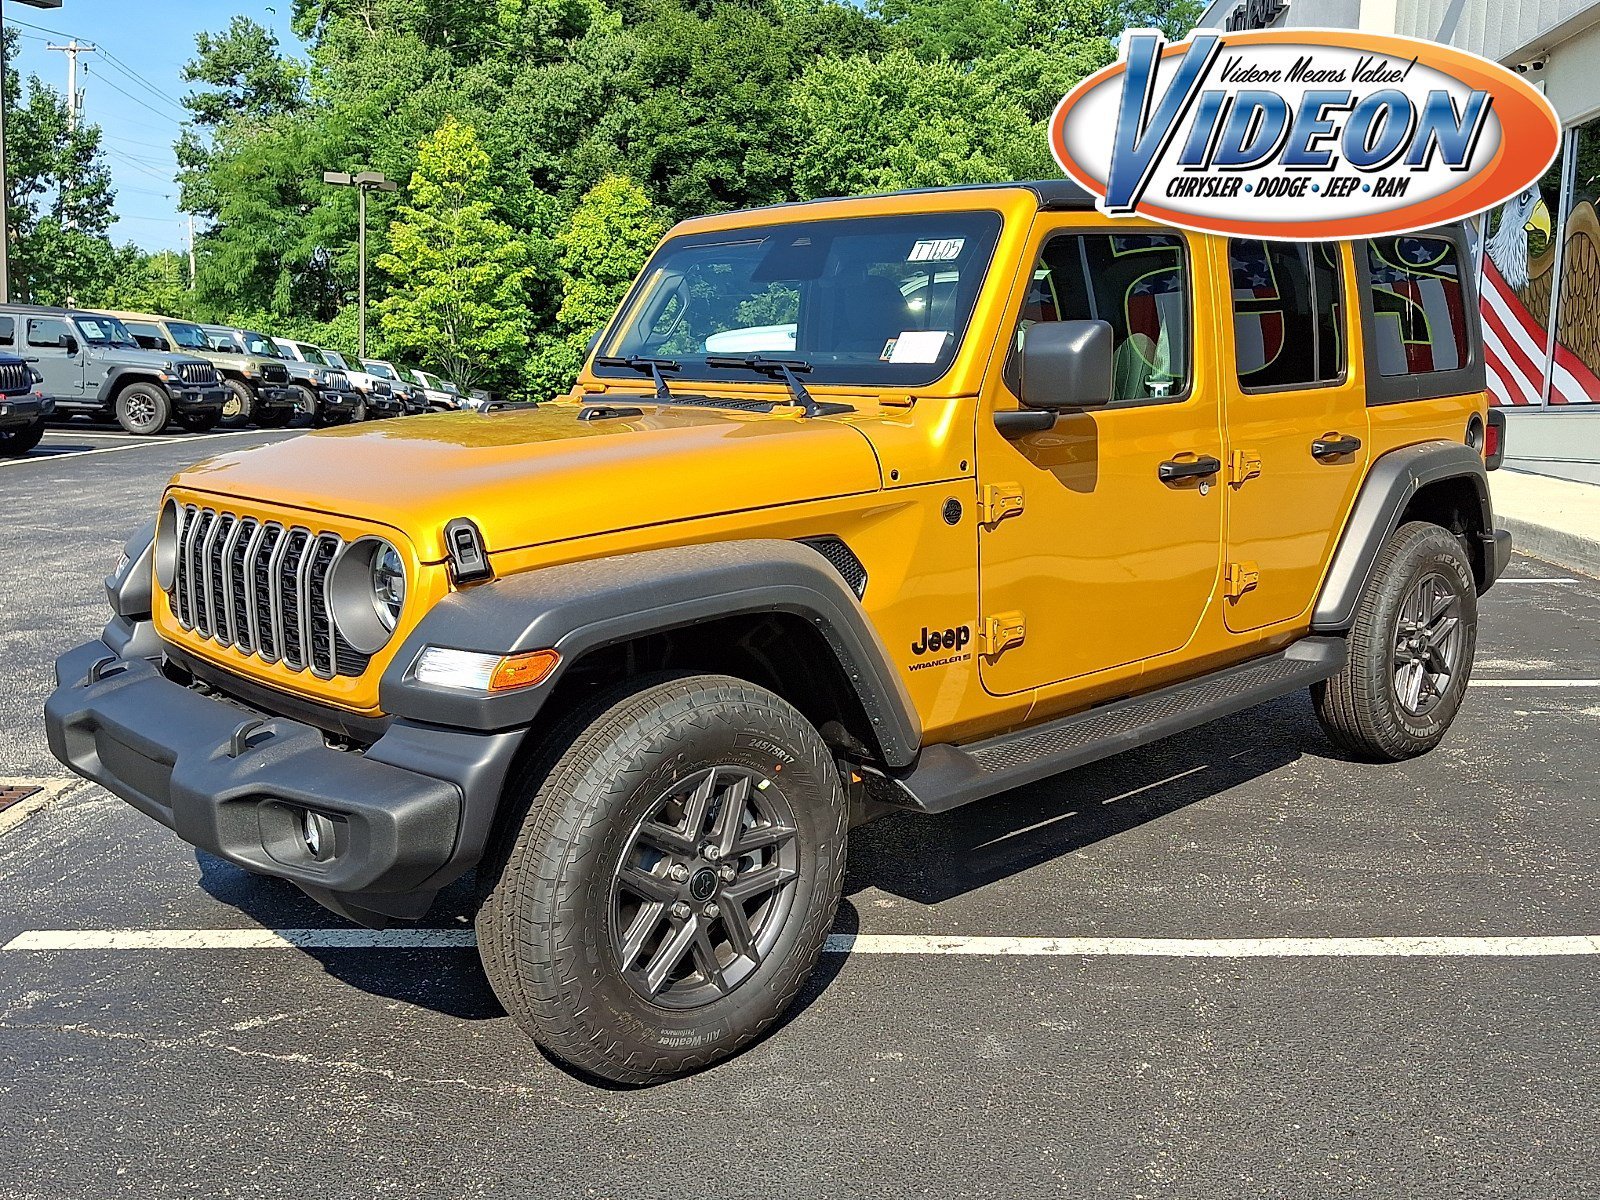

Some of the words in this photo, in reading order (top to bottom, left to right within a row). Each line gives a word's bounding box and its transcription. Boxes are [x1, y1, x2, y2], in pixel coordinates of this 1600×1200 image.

[1436, 553, 1470, 589] NEXEN
[911, 625, 970, 655] Jeep
[908, 655, 962, 671] WRANGLER
[748, 738, 795, 764] 245/75R17
[658, 1029, 721, 1047] All-Weather
